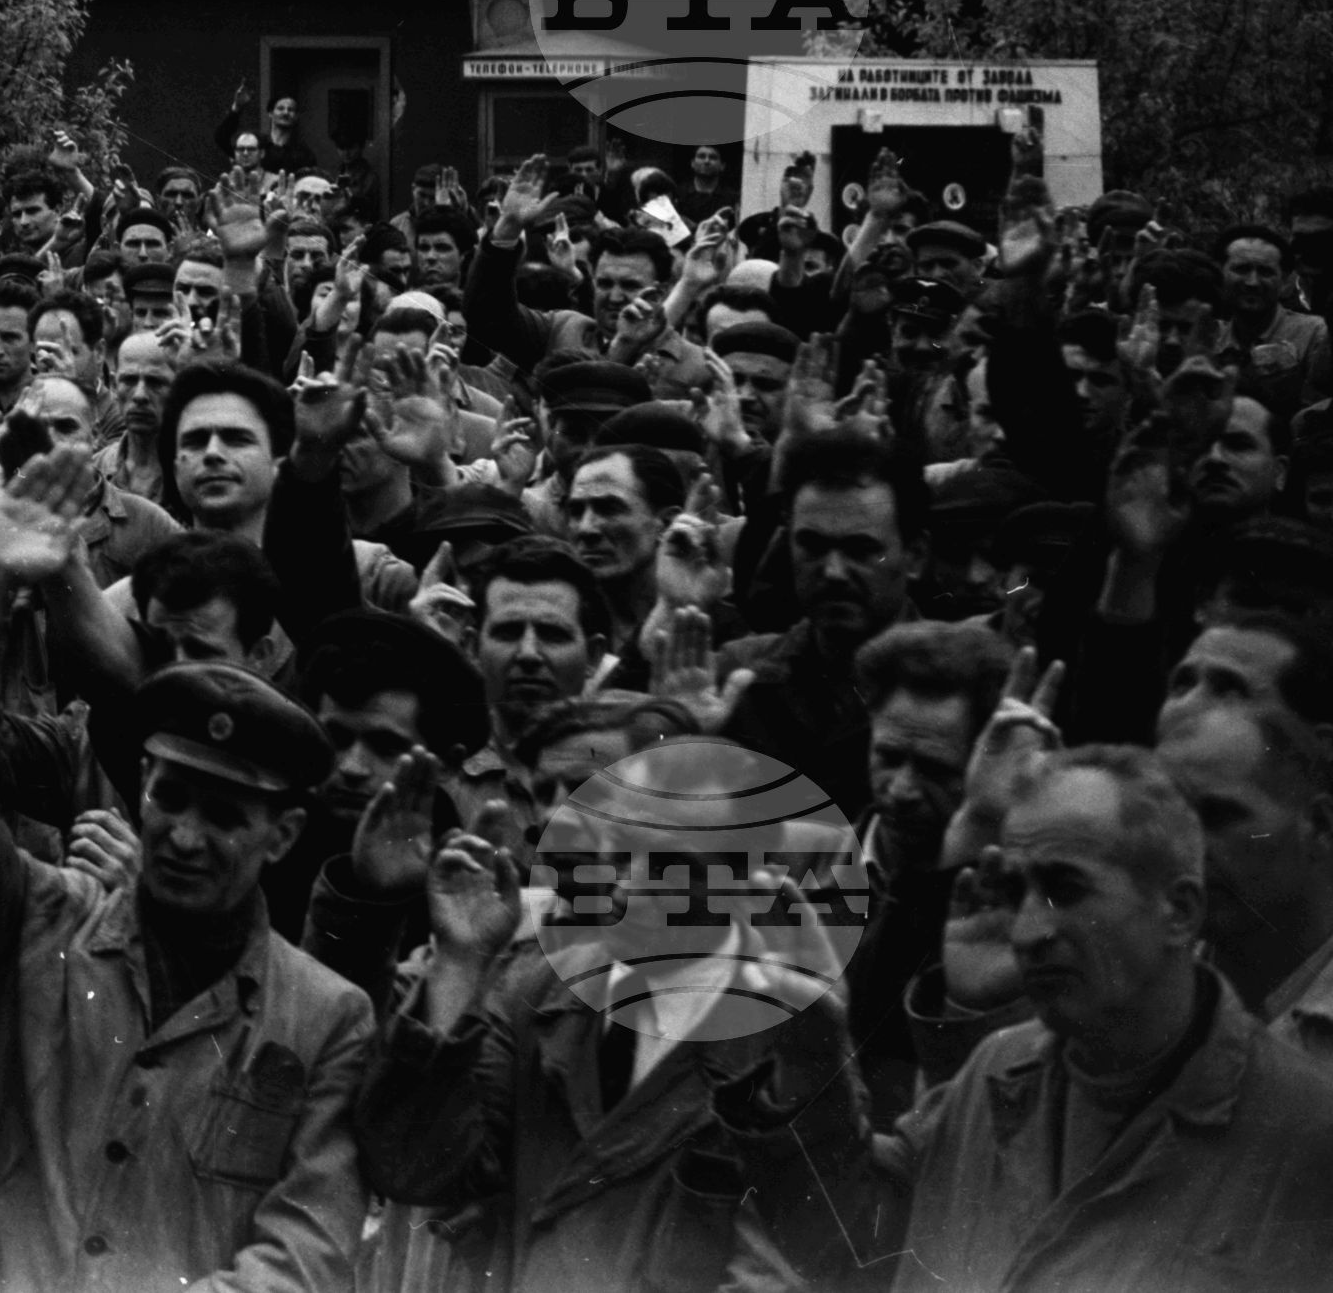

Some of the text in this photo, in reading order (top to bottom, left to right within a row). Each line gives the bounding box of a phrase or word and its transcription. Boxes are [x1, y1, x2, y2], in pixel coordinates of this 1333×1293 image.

[838, 69, 854, 83] НА
[957, 69, 973, 85] ОТ
[944, 88, 992, 103] ПРОТИВ
